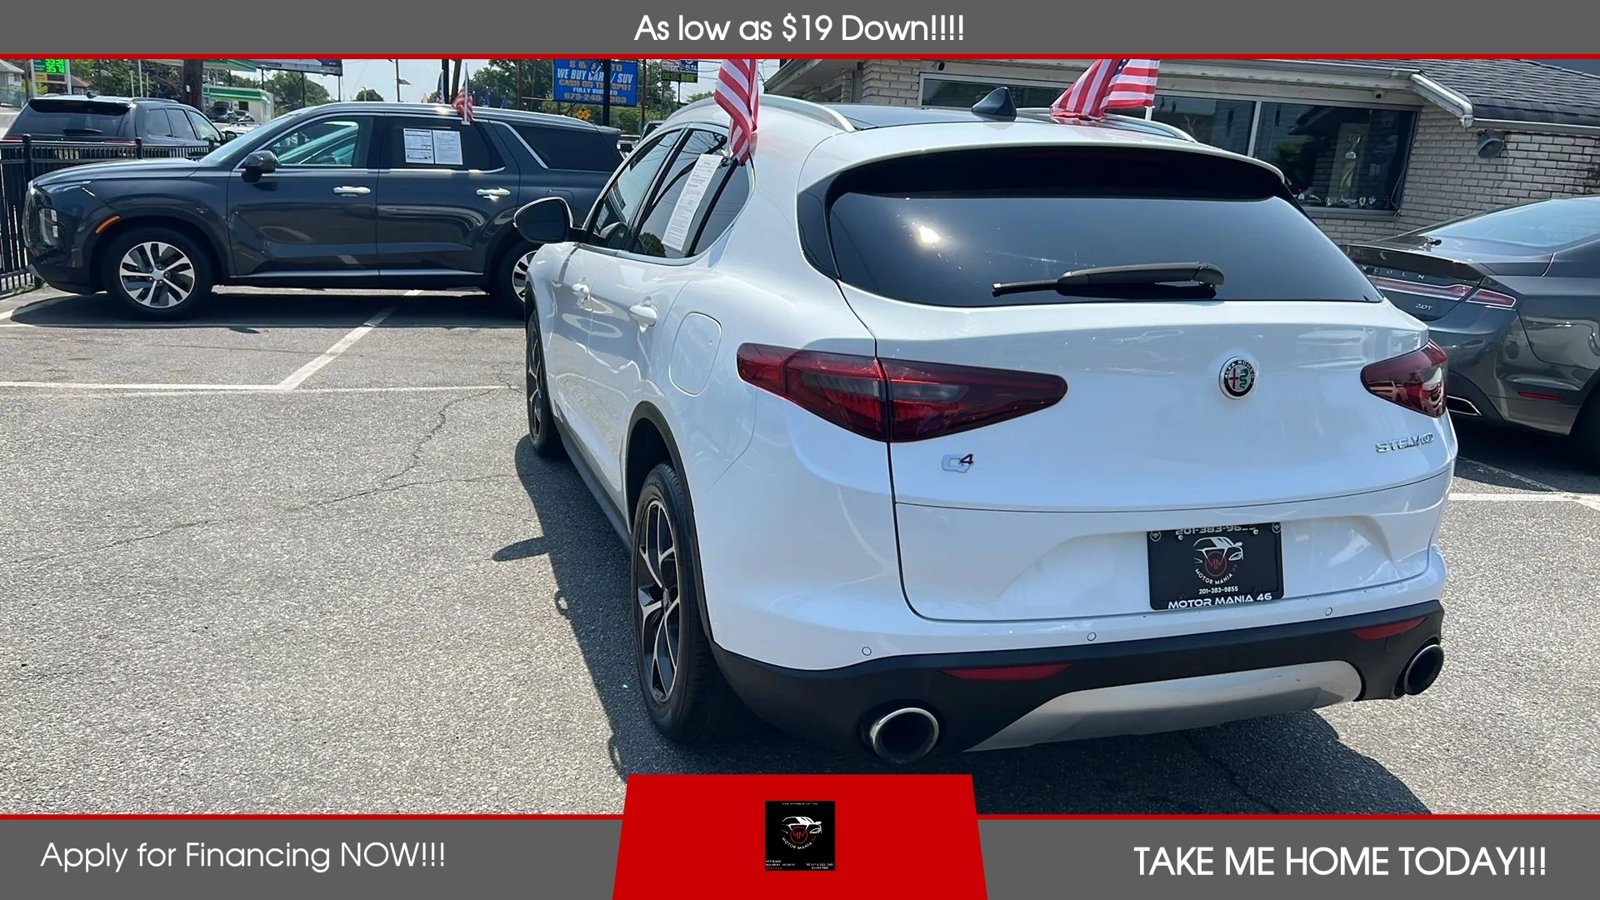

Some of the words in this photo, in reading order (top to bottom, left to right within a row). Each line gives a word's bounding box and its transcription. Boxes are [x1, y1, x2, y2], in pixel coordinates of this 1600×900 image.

[557, 67, 570, 79] WE
[570, 69, 587, 80] BUY
[587, 69, 605, 82] CAR
[617, 73, 634, 84] SUV
[1194, 568, 1214, 585] MOTOR
[1214, 572, 1234, 585] MANIA
[1168, 598, 1212, 609] MOTOR
[1214, 595, 1254, 606] MANIA
[1256, 592, 1273, 602] 46
